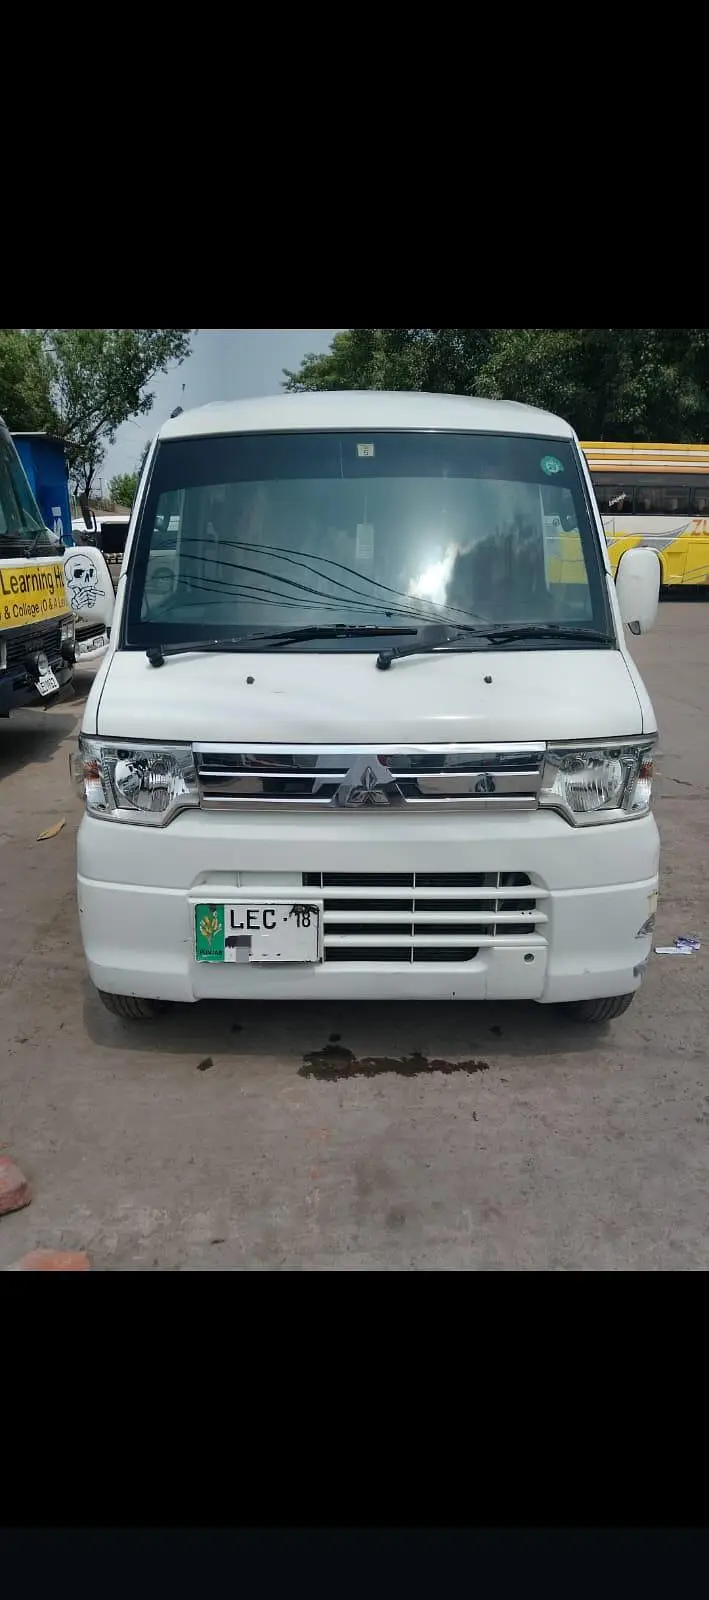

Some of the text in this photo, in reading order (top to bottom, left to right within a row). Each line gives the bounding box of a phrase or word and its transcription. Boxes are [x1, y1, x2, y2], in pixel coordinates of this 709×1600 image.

[0, 568, 55, 595] Learning
[4, 605, 11, 620] &
[12, 603, 40, 617] College
[230, 909, 277, 930] LEC
